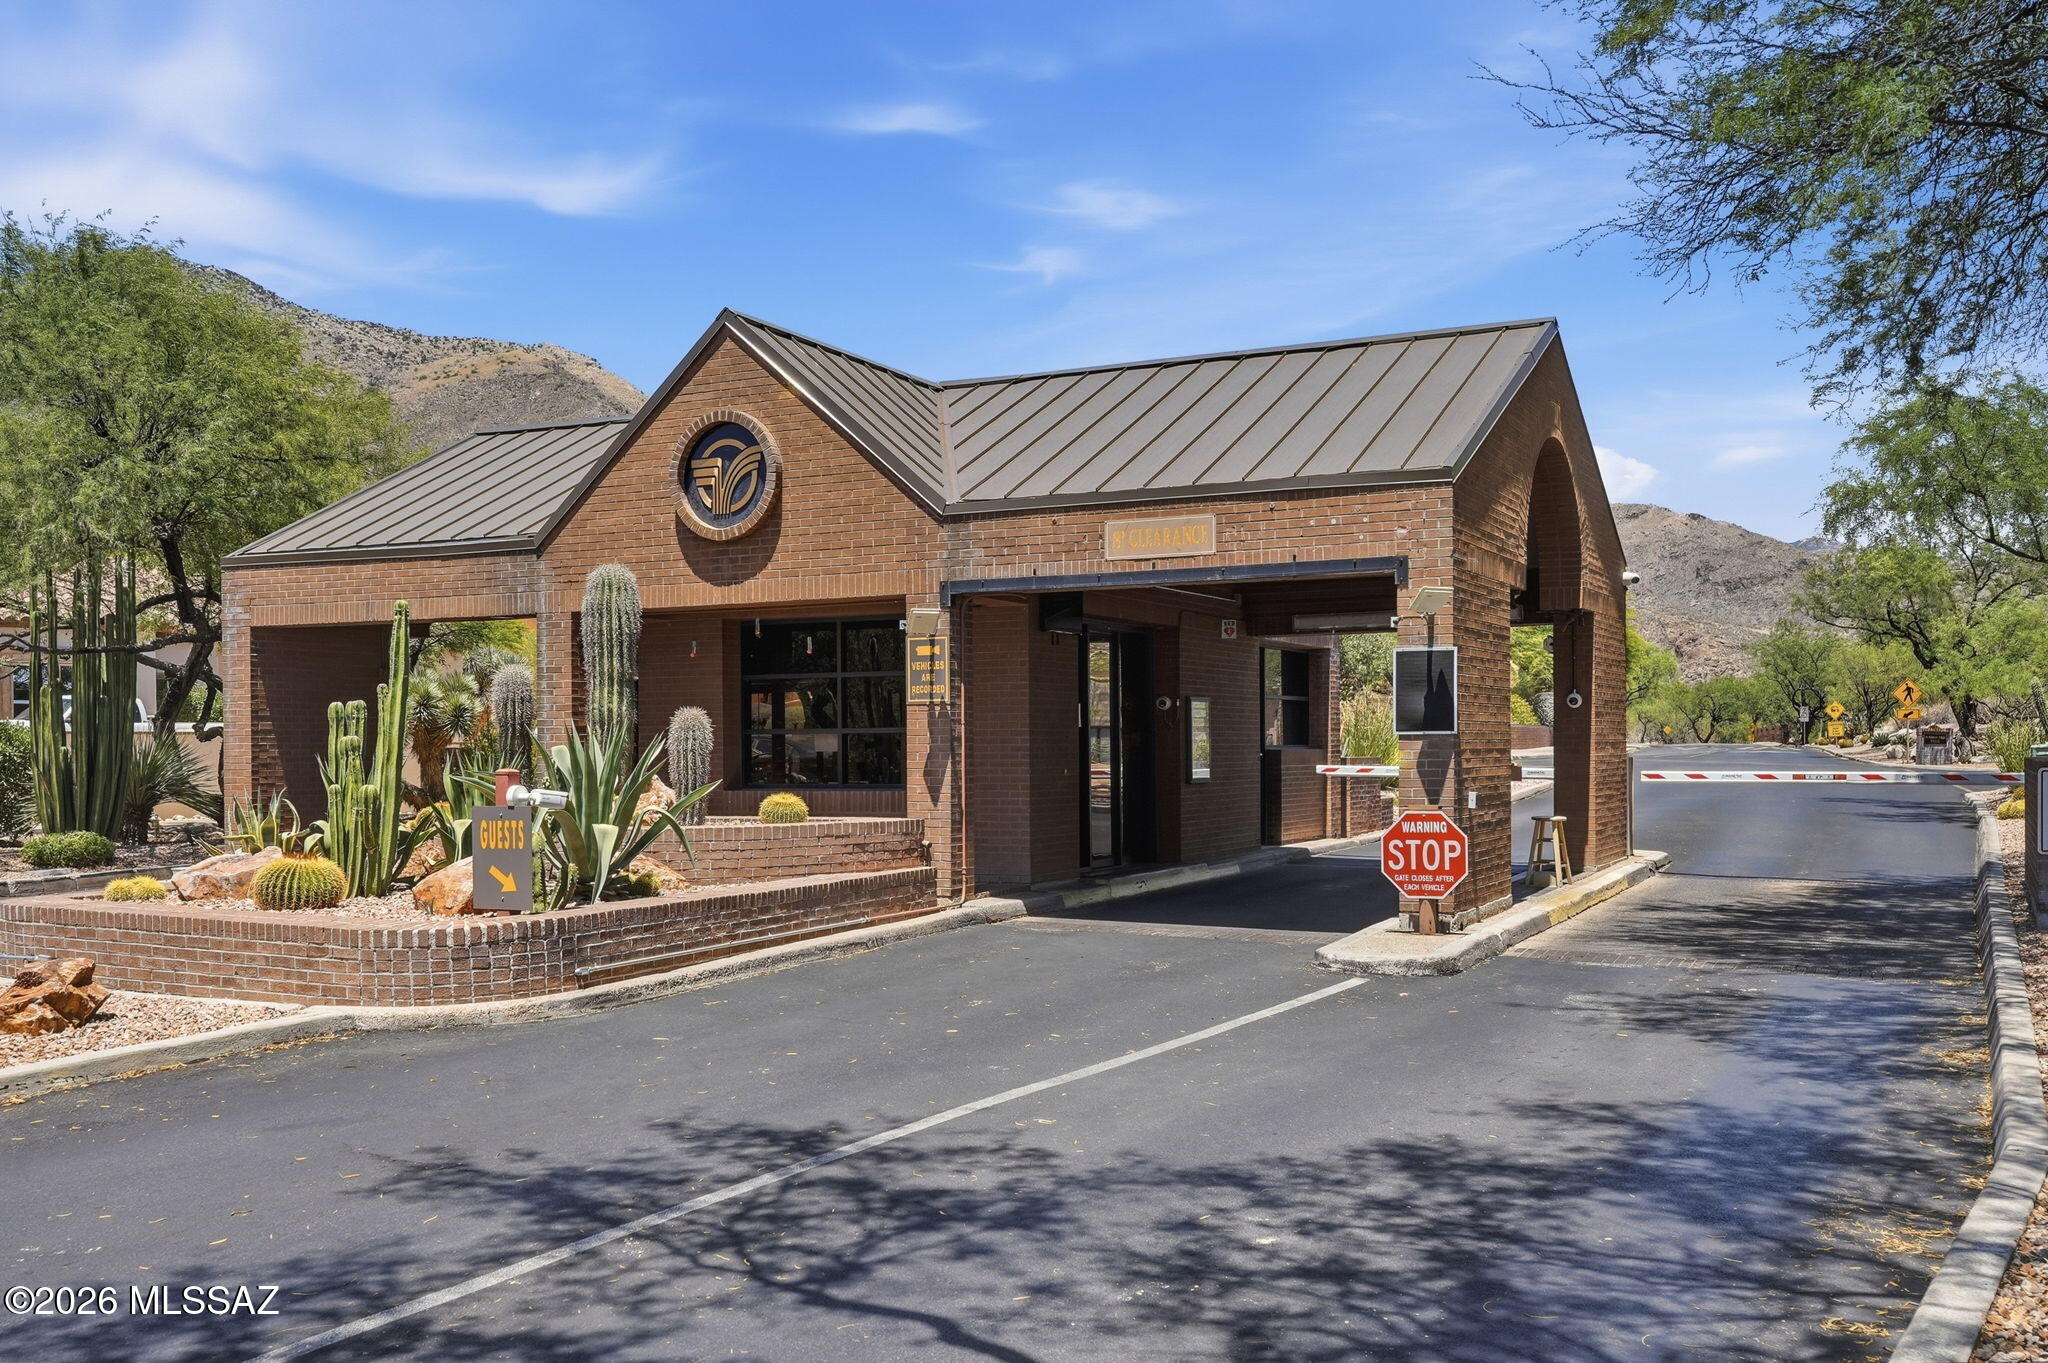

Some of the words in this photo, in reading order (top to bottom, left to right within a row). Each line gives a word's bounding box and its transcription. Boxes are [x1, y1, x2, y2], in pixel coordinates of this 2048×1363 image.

[1128, 525, 1209, 548] CLEARANCE
[921, 673, 936, 682] ARE
[911, 684, 945, 694] RECORDED
[1401, 821, 1447, 833] WARNING
[480, 819, 524, 850] GUESTS
[1388, 839, 1462, 871] STOP
[1411, 874, 1433, 882] CLOSES
